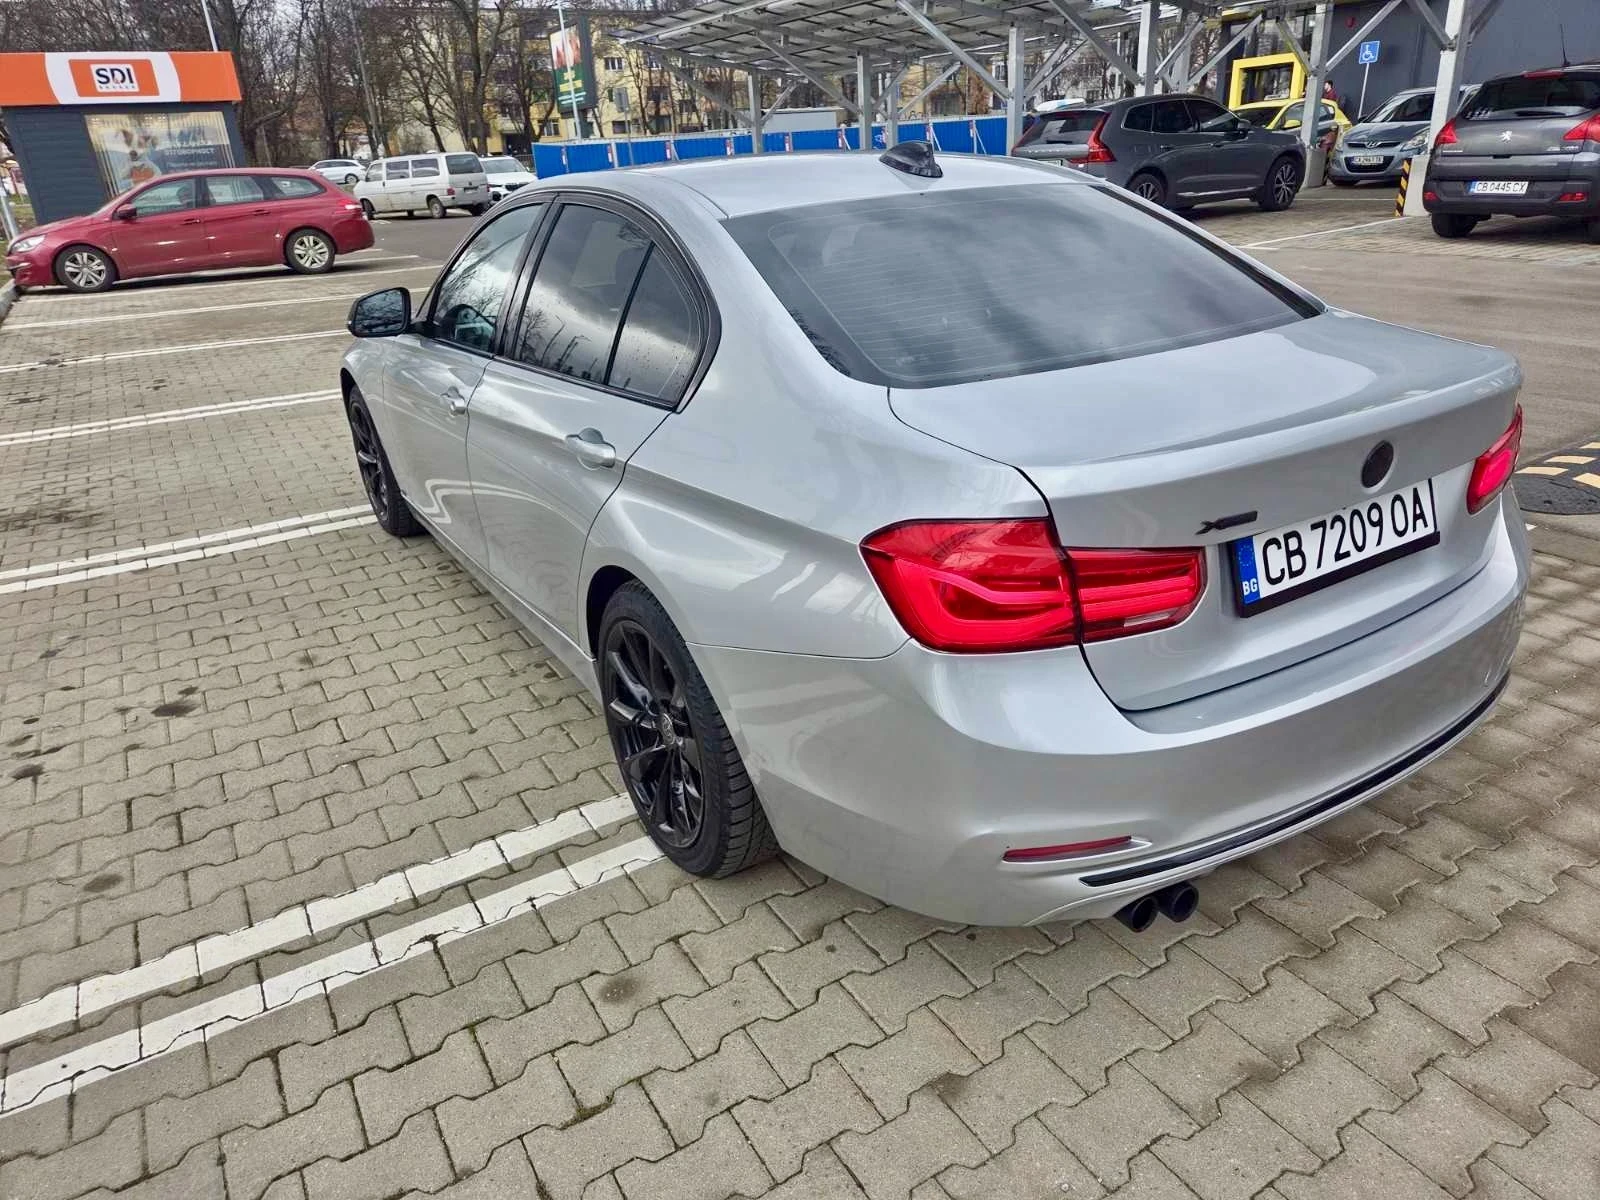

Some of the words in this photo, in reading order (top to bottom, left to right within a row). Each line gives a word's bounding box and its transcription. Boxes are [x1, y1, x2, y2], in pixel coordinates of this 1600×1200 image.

[95, 68, 134, 84] SDI
[1476, 182, 1488, 192] CB
[1489, 182, 1512, 192] 0445
[1512, 182, 1526, 192] CX
[1262, 530, 1307, 586] CB
[1310, 502, 1384, 570] 7209
[1390, 487, 1429, 538] OA
[1242, 579, 1258, 595] BG
